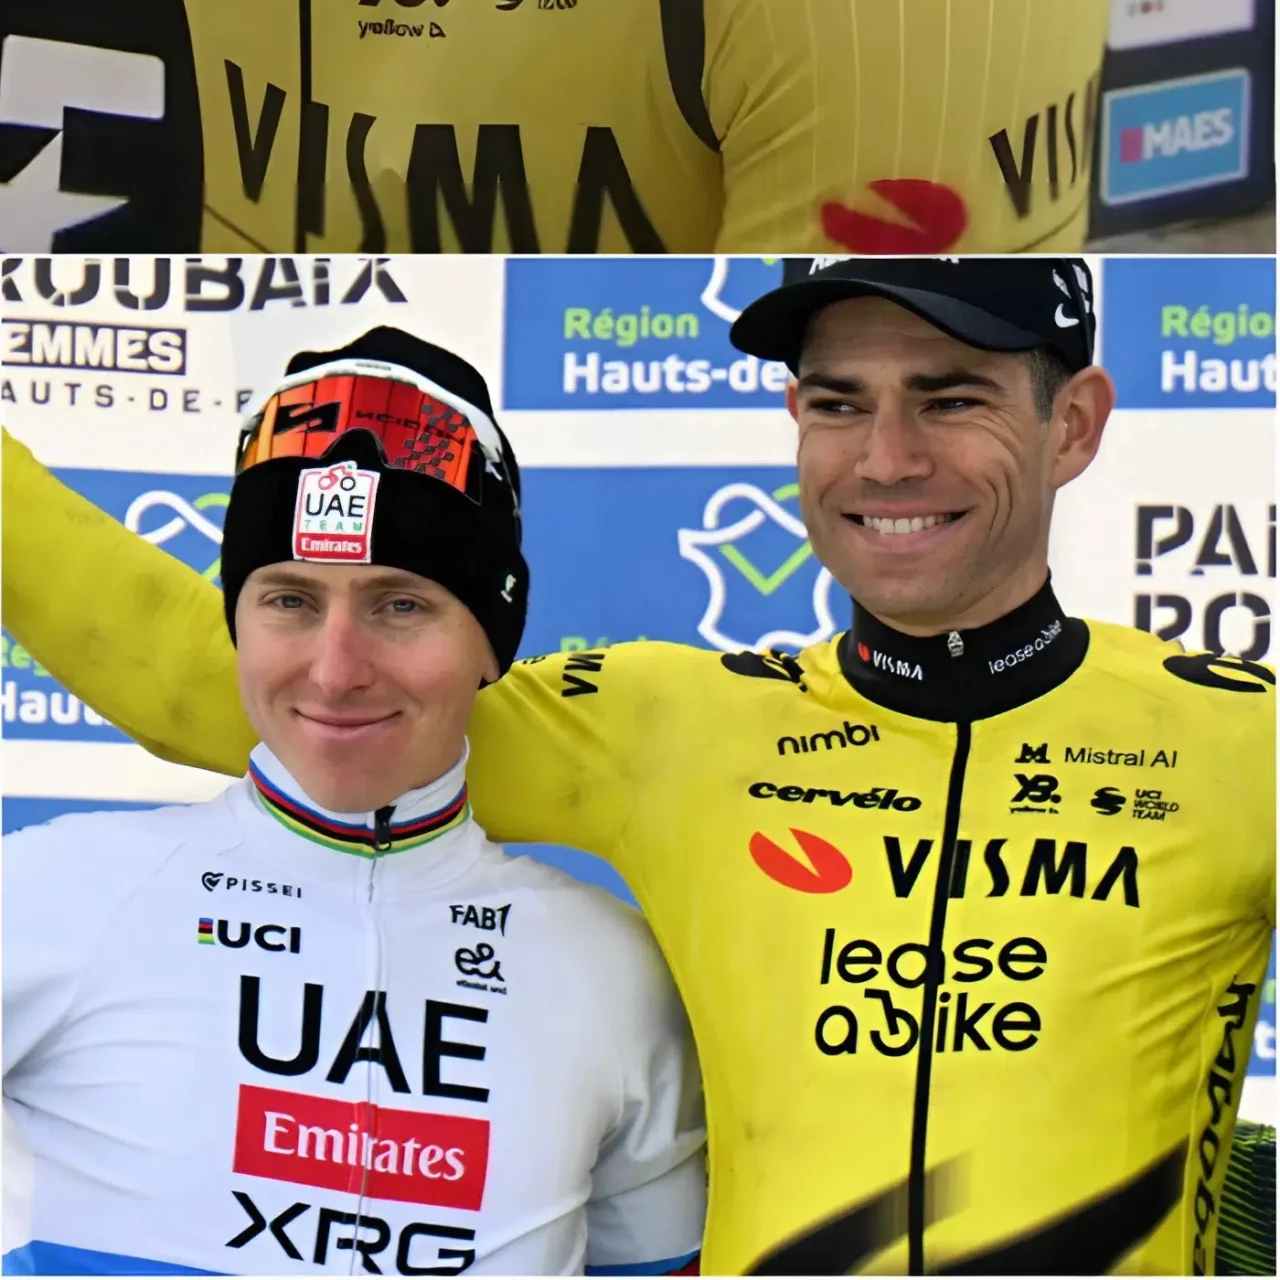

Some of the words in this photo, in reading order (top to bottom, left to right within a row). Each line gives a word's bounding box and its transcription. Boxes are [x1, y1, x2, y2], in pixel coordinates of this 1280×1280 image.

[1140, 107, 1235, 161] MAES
[563, 306, 699, 347] Région
[305, 493, 366, 518] UAE
[300, 537, 363, 554] Emirates
[873, 650, 924, 681] VISMA
[777, 721, 881, 756] nimbi
[1064, 746, 1146, 767] Mistral
[1150, 750, 1178, 769] AI
[749, 782, 923, 812] cervélo
[226, 875, 303, 899] PISSEI
[881, 835, 1141, 908] VISMA
[217, 918, 302, 954] UCI
[819, 927, 1048, 990] lease
[238, 974, 490, 1103] UAE
[263, 1111, 466, 1181] Emirates
[225, 1190, 477, 1276] XRG
